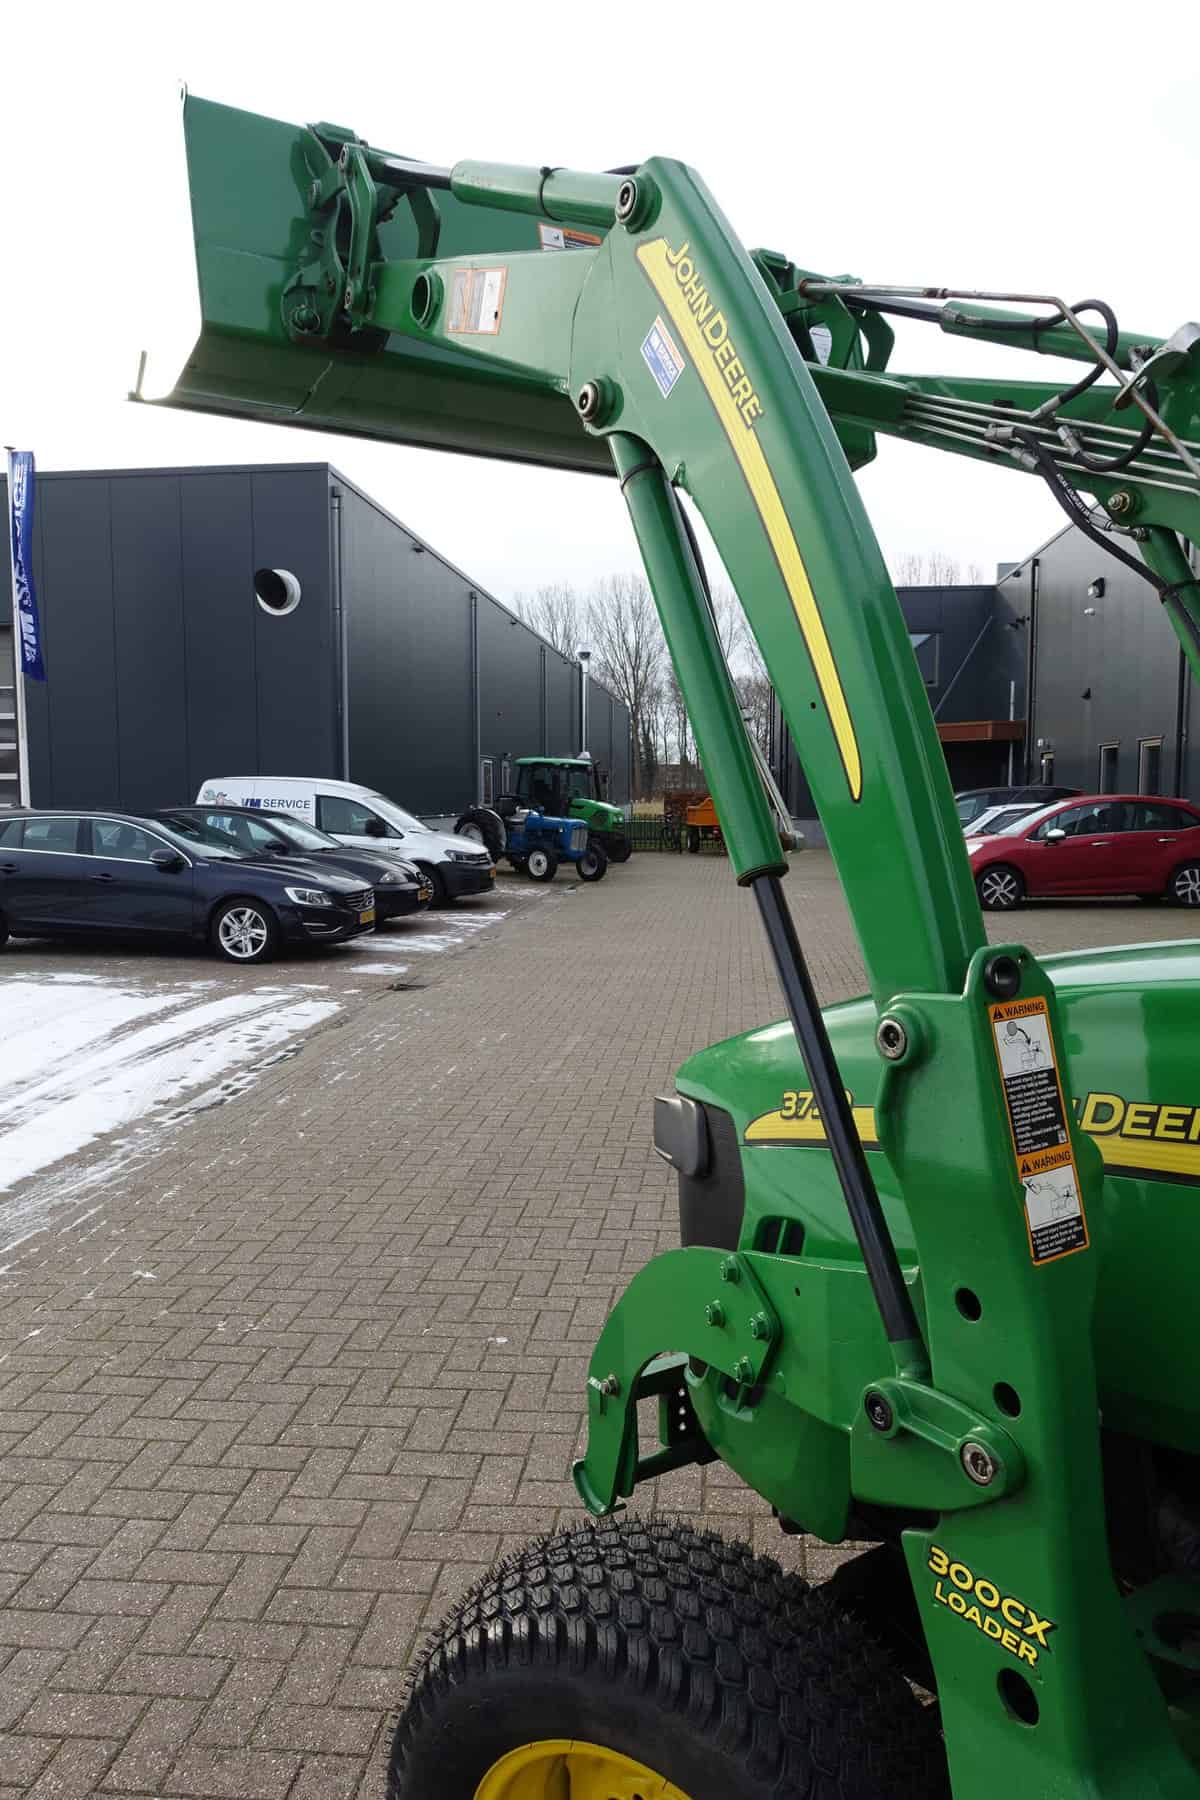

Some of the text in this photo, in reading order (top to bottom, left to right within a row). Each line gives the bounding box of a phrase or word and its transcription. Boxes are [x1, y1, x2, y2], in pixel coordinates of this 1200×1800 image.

[263, 799, 311, 809] SERVICE
[1004, 1001, 1045, 1017] WARNING
[1031, 1150, 1071, 1169] WARNING
[928, 1546, 1054, 1648] 300CX
[935, 1581, 1038, 1667] LOADER
